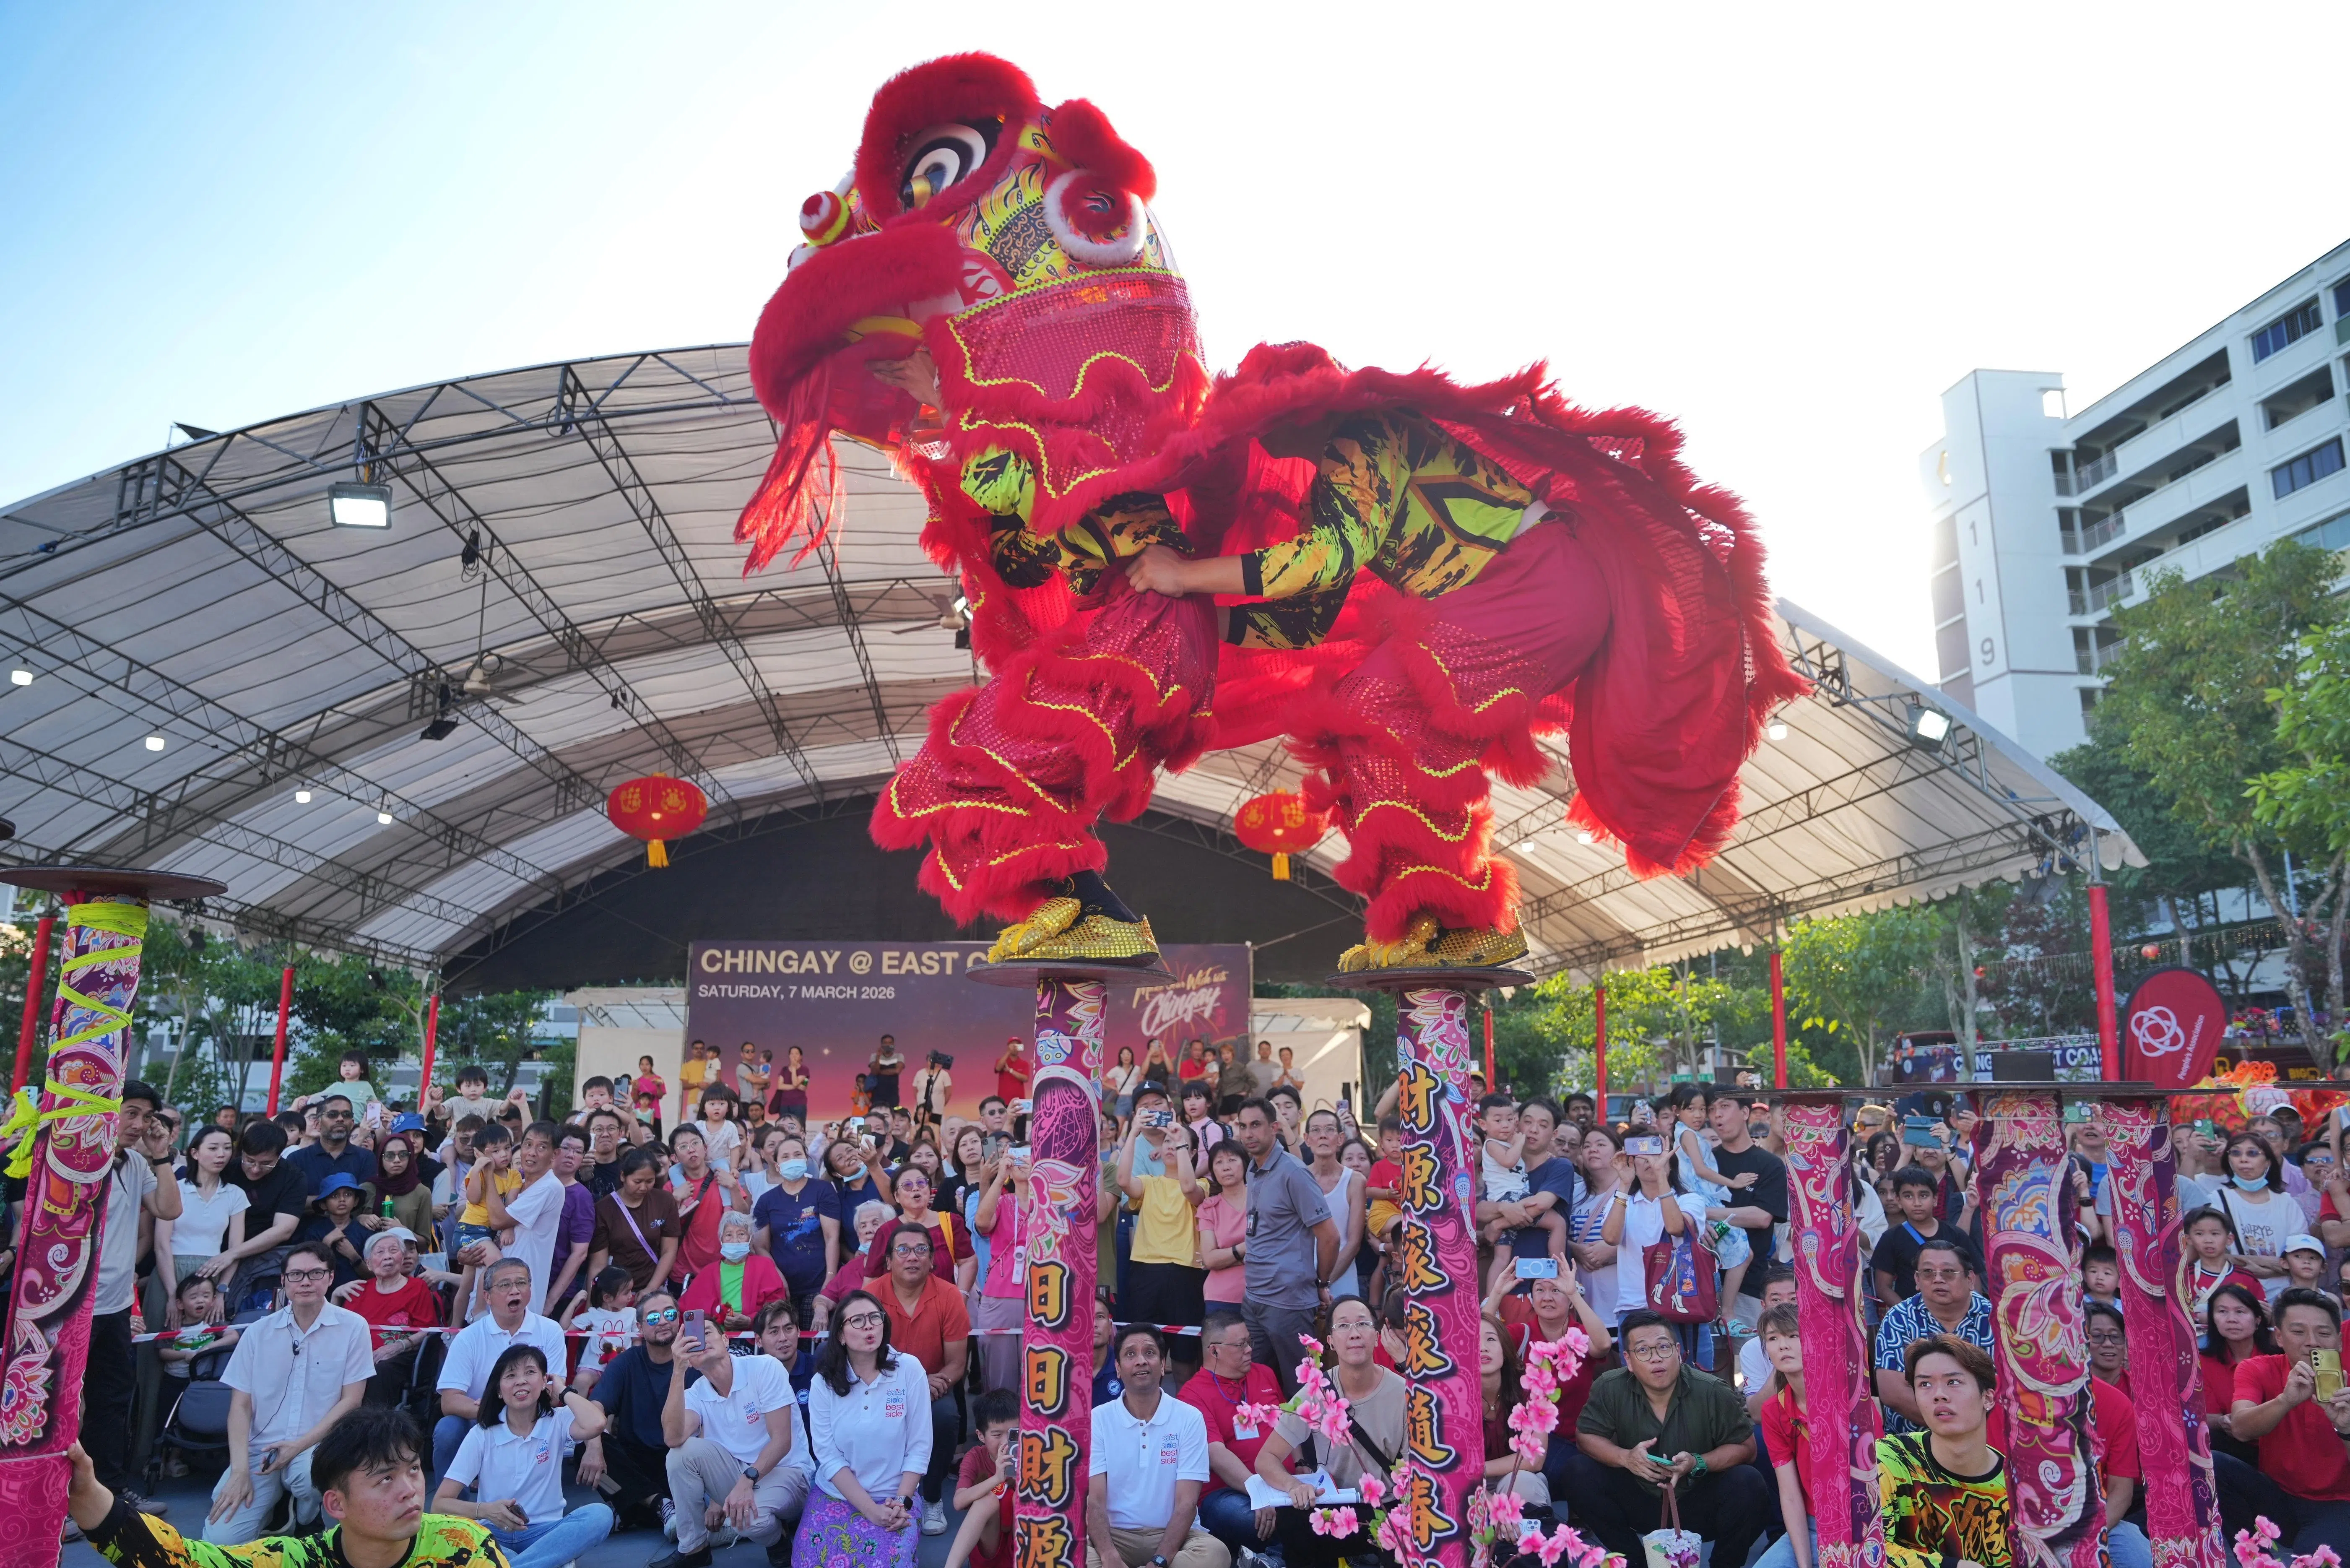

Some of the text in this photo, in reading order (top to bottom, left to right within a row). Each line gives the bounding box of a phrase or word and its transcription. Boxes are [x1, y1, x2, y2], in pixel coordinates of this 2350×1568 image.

[1969, 520, 1996, 666] 119
[701, 949, 841, 974] CHINGAY
[849, 950, 873, 975] @
[882, 951, 959, 975] EAST
[698, 984, 895, 1000] SATURDAY, 7 MARCH 2026
[1141, 986, 1221, 1036] Chingay
[2177, 1014, 2205, 1081] People's Association
[746, 1411, 759, 1420] best
[748, 1416, 760, 1425] side
[537, 1456, 549, 1464] side
[1160, 1456, 1177, 1464] side
